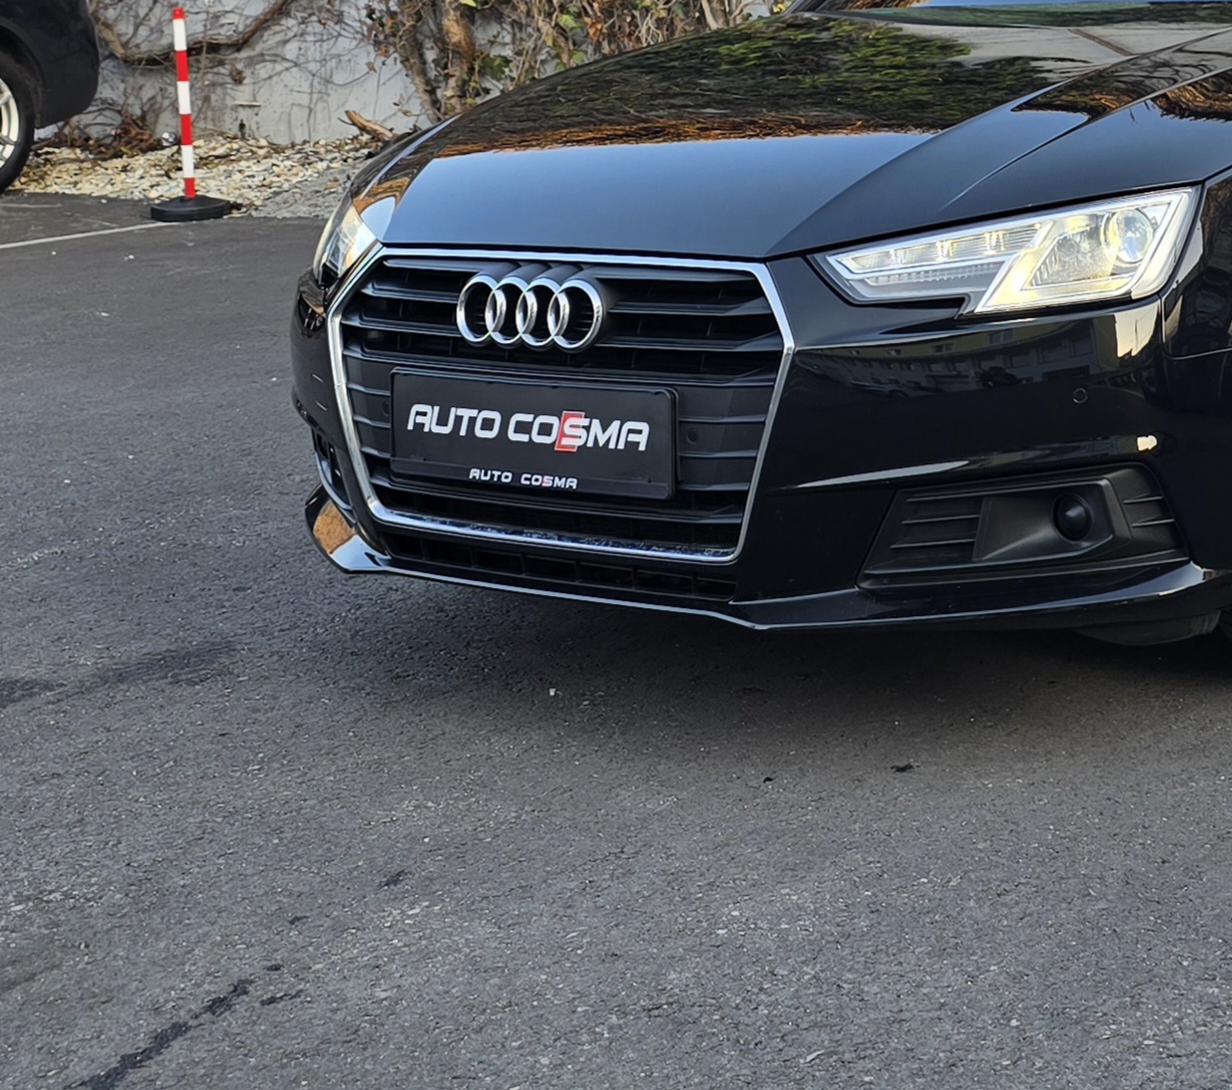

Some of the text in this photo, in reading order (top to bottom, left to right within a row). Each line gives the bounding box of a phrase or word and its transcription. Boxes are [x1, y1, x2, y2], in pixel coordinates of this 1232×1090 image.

[407, 403, 650, 451] AUTO COSMA
[469, 468, 578, 490] AUTO COSMA
